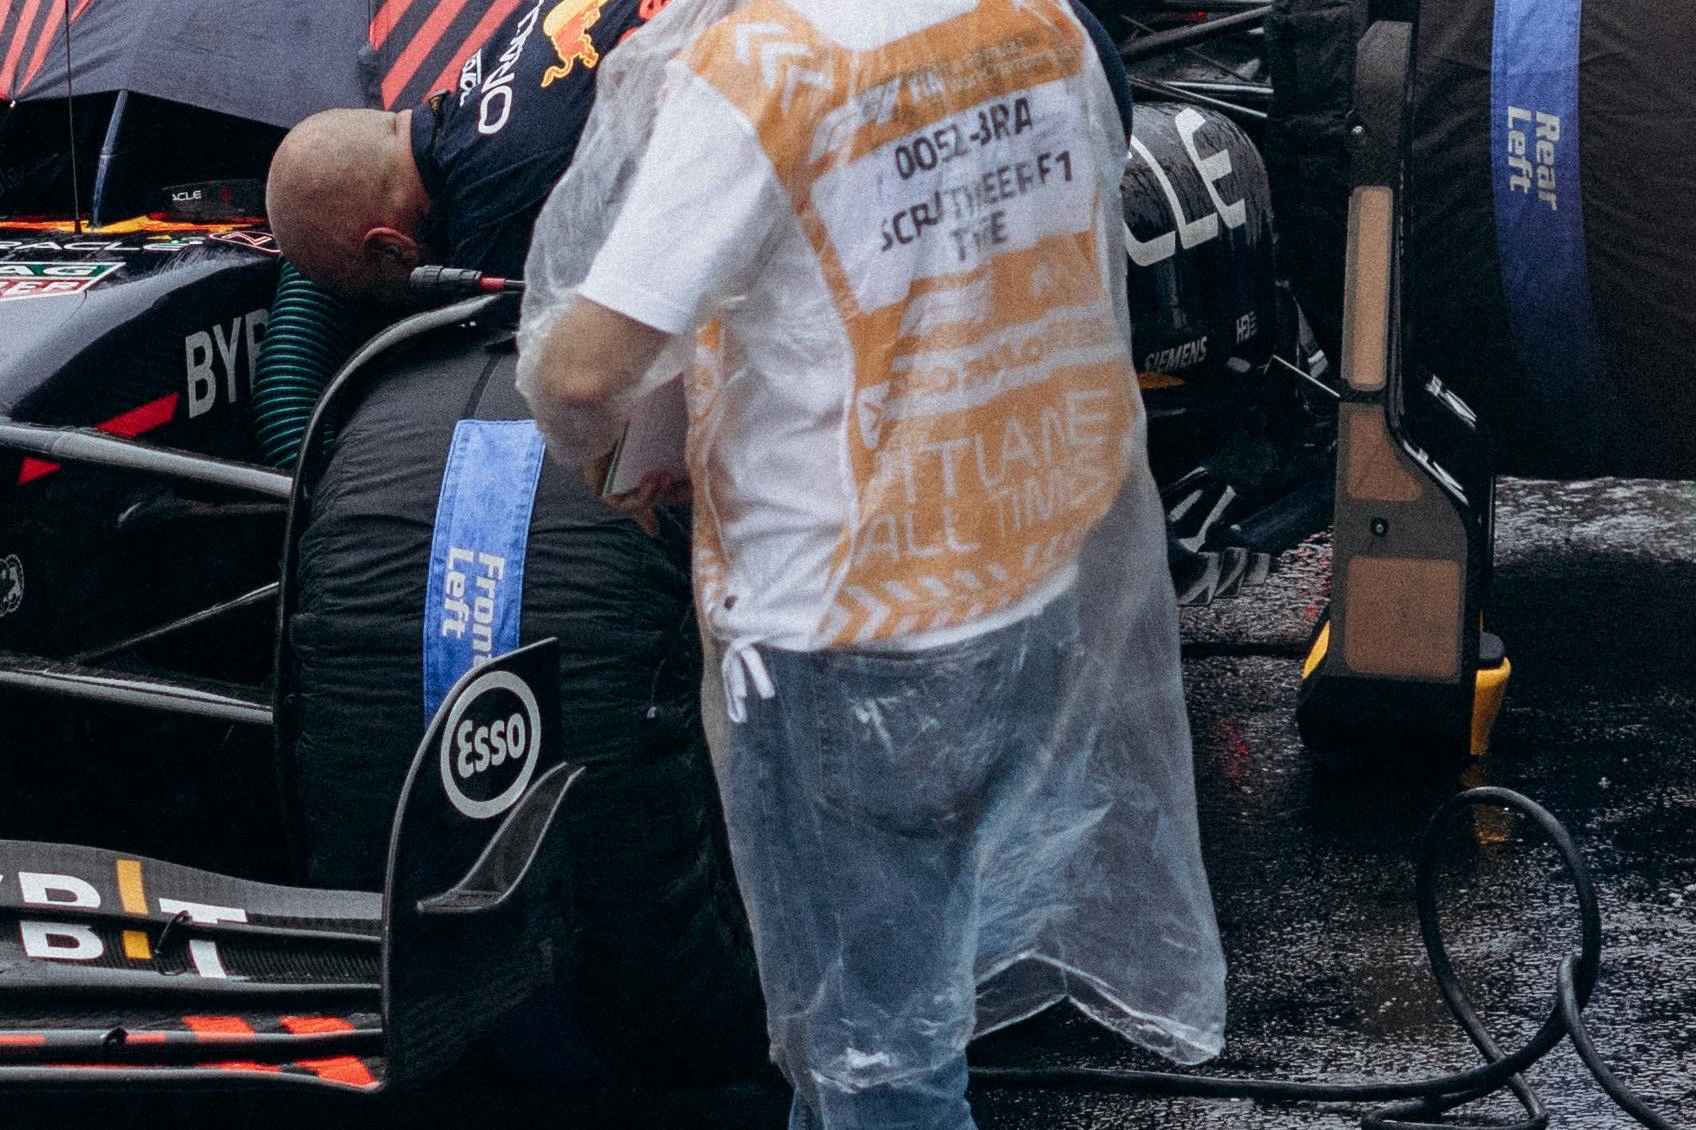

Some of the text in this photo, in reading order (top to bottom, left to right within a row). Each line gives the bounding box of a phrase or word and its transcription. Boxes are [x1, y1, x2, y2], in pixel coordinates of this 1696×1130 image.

[1507, 104, 1533, 195] Left
[1536, 111, 1561, 211] Rear
[855, 504, 982, 567] ALL
[441, 546, 474, 640] Left
